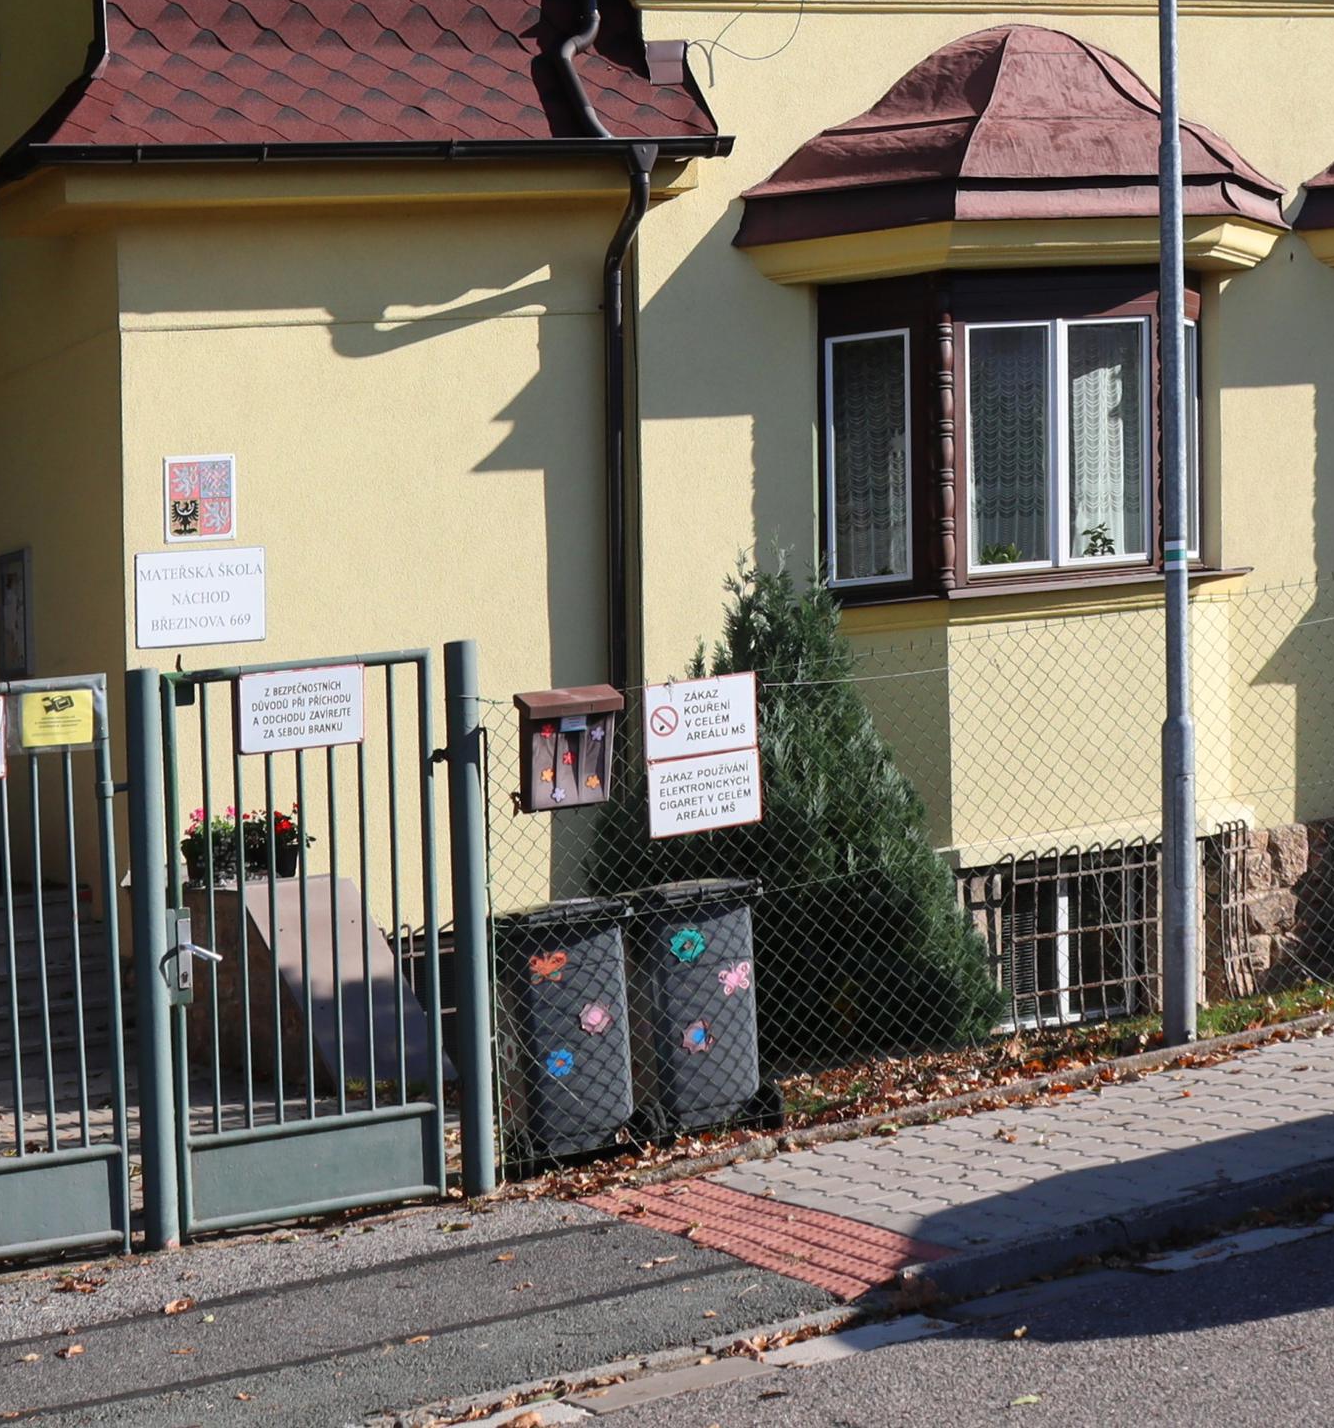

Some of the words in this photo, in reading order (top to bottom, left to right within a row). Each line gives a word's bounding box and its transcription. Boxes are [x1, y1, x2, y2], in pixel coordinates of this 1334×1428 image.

[139, 563, 214, 582] MATEŘSKÁ
[218, 562, 263, 577] ŠKOLA
[172, 590, 230, 606] NÁCHOD
[151, 615, 225, 632] BŘEZINOVA
[230, 613, 251, 627] 669
[265, 688, 270, 697] Z
[273, 680, 341, 696] BEZPEČNOSTNÍCH
[684, 689, 719, 702] ZÁKAZ
[252, 698, 288, 712] DŮVODŮ
[292, 697, 305, 708] PŘI
[309, 694, 351, 706] PŘÍCHODU
[684, 699, 731, 715] KOUŘENÍ
[253, 717, 259, 726] A
[263, 712, 306, 725] ODCHODU
[309, 707, 351, 721] ZAVÍREJTE
[685, 720, 691, 728] V
[695, 713, 730, 727] CELÉM
[263, 730, 275, 739] ZA
[278, 726, 305, 738] SEBOU
[309, 722, 343, 734] BRANKU
[687, 728, 728, 741] AREÁLU
[732, 723, 746, 735] MŠ
[660, 772, 693, 785] ZÁKAZ
[698, 760, 749, 778] POUŽÍVÁNÍ
[660, 775, 750, 798] ELEKTRONICKÝCH
[659, 796, 704, 811] CIGARET
[708, 794, 714, 803] V
[718, 788, 752, 802] CELÉM
[676, 807, 717, 822] AREÁLU
[722, 801, 736, 813] MŠ
